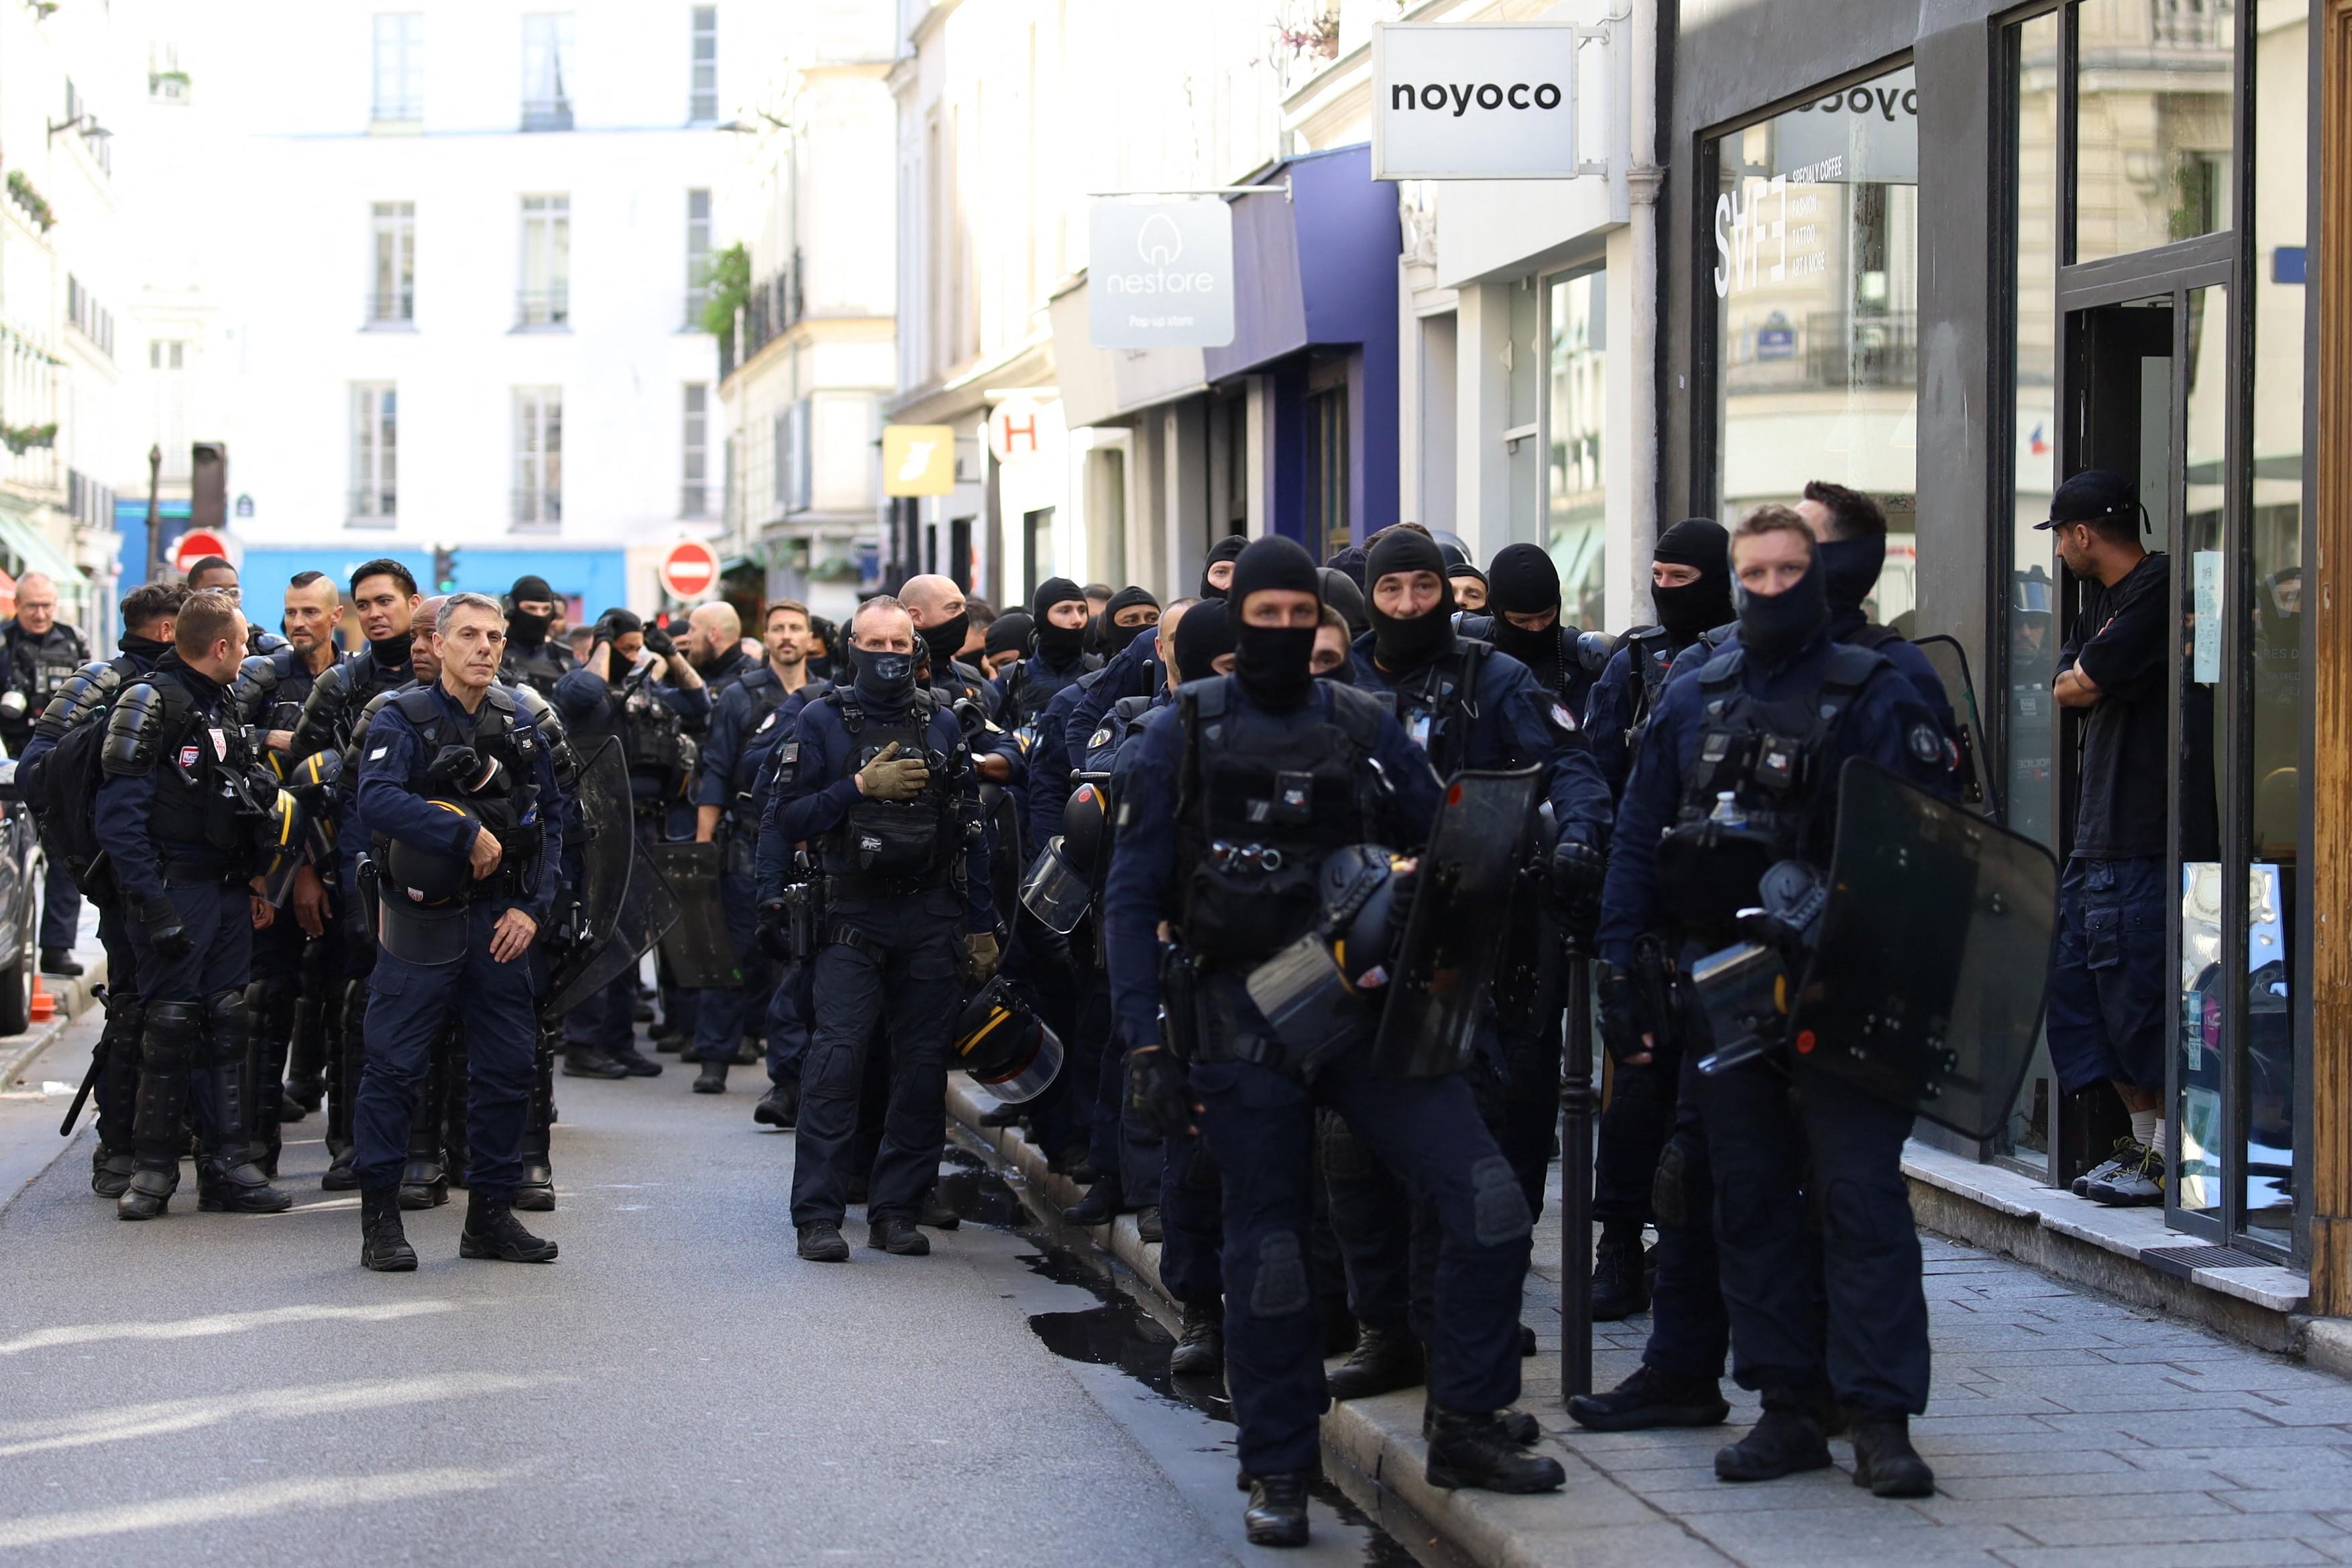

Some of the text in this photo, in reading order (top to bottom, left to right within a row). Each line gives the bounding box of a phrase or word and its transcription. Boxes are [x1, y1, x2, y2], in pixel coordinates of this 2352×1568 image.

[1392, 83, 1562, 117] noyoco
[1792, 155, 1842, 189] SPECIALY COFFEE
[1792, 193, 1817, 219] FASHION
[1792, 223, 1815, 247] TATTOO
[1792, 256, 1803, 278] ART
[1809, 251, 1826, 274] MORE
[1106, 268, 1214, 294] nestore
[1129, 315, 1194, 328] Pop-up store
[1005, 414, 1036, 452] H
